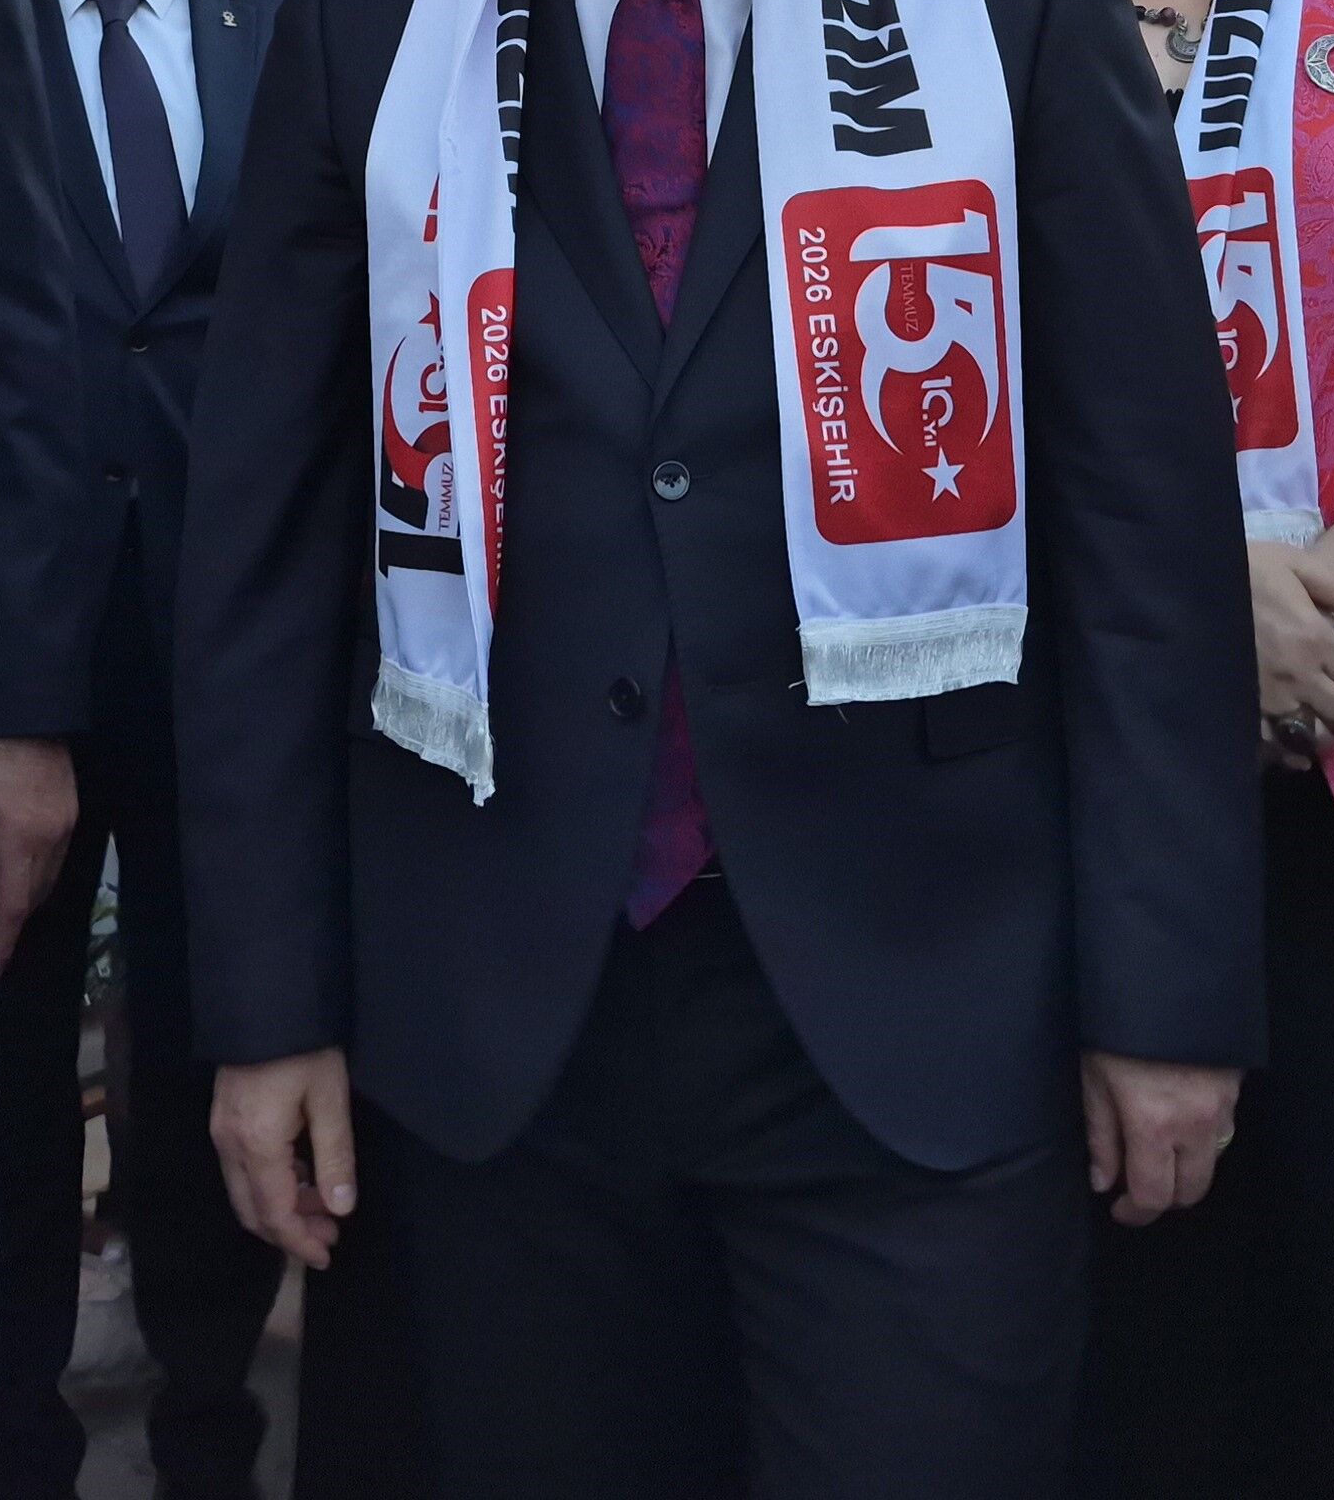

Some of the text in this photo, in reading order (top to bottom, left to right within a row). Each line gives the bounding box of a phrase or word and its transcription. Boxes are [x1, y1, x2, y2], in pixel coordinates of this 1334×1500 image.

[848, 207, 1001, 456] 15
[897, 262, 920, 333] TEMMUZ
[480, 303, 509, 382] 2026
[798, 226, 860, 506] 2026 ESKİŞEHİR
[438, 460, 455, 532] TEMMUZ
